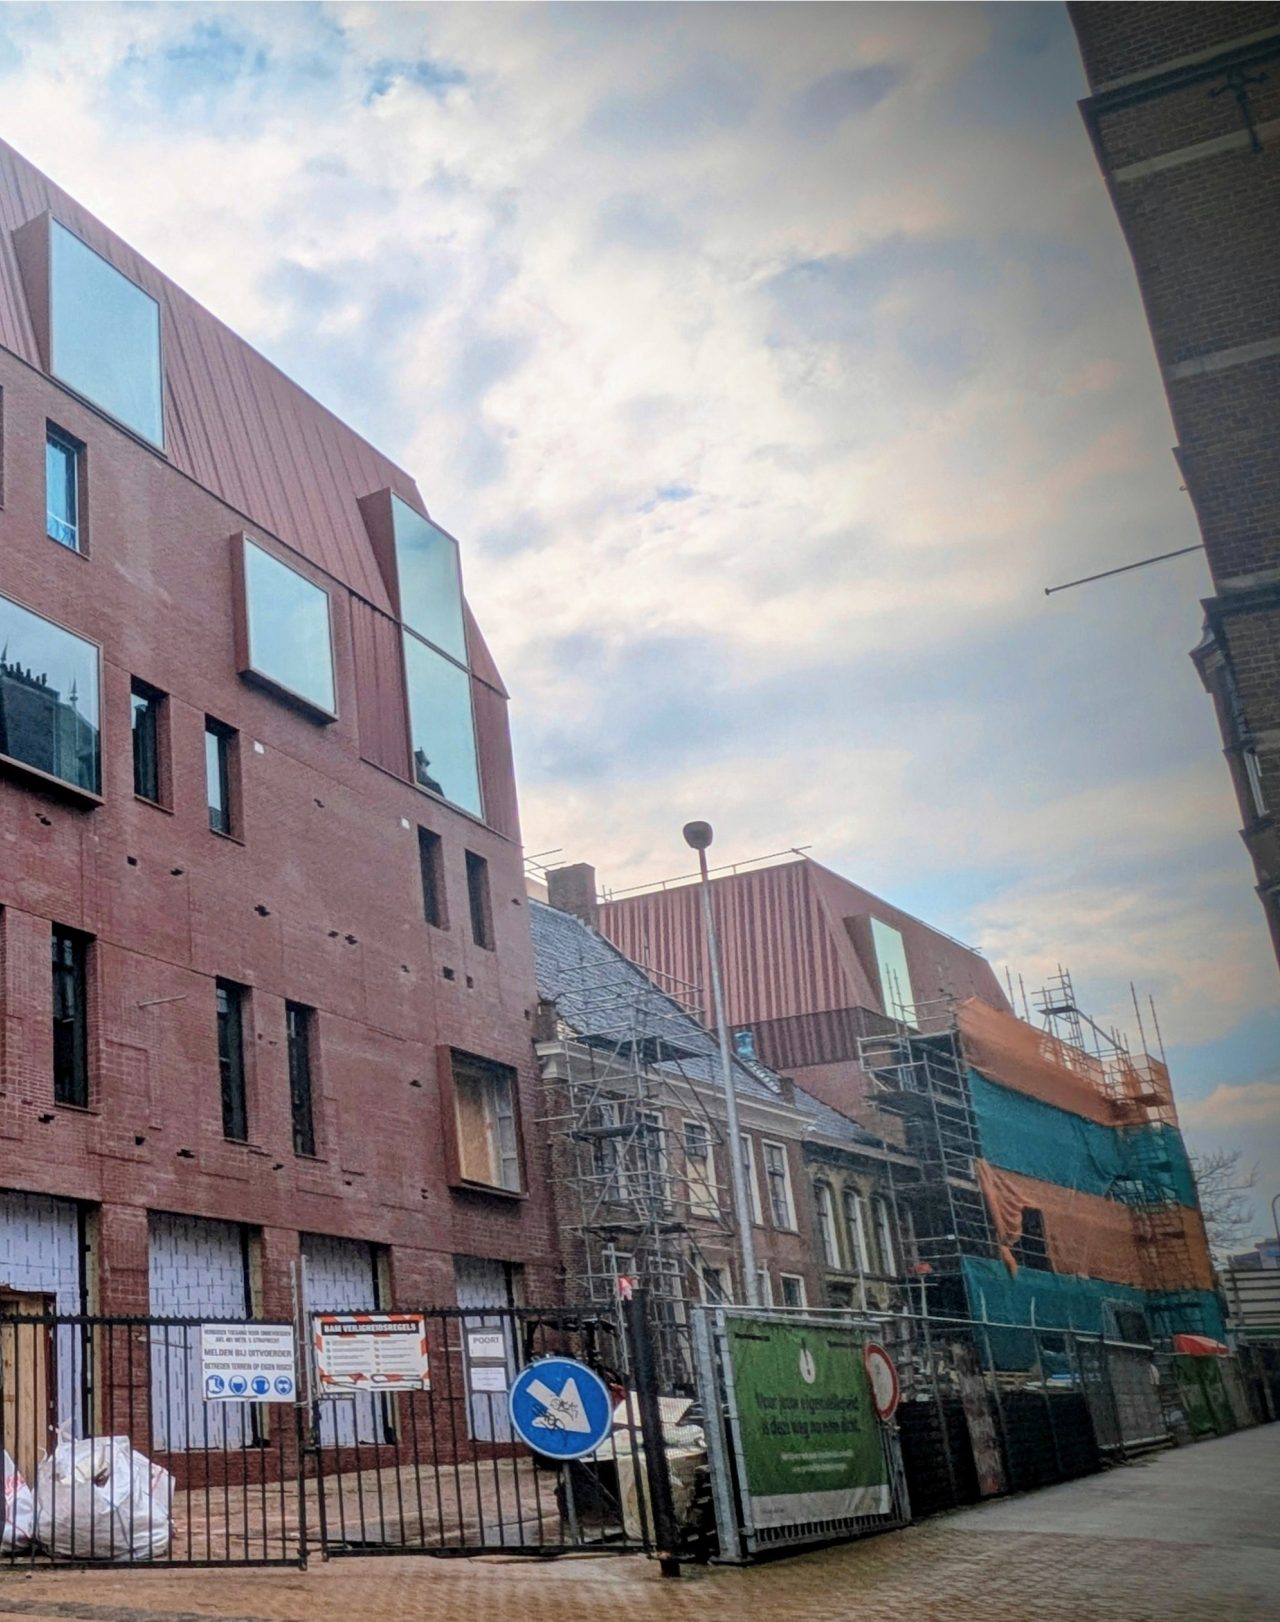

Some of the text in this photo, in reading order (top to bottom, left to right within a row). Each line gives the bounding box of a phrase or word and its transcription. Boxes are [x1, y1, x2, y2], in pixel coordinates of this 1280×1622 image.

[324, 1323, 417, 1333] BAM VEILIGHEIDSREGELS
[473, 1336, 499, 1344] POORT
[204, 1348, 233, 1356] MELDEN
[248, 1349, 292, 1357] UITVOERDER
